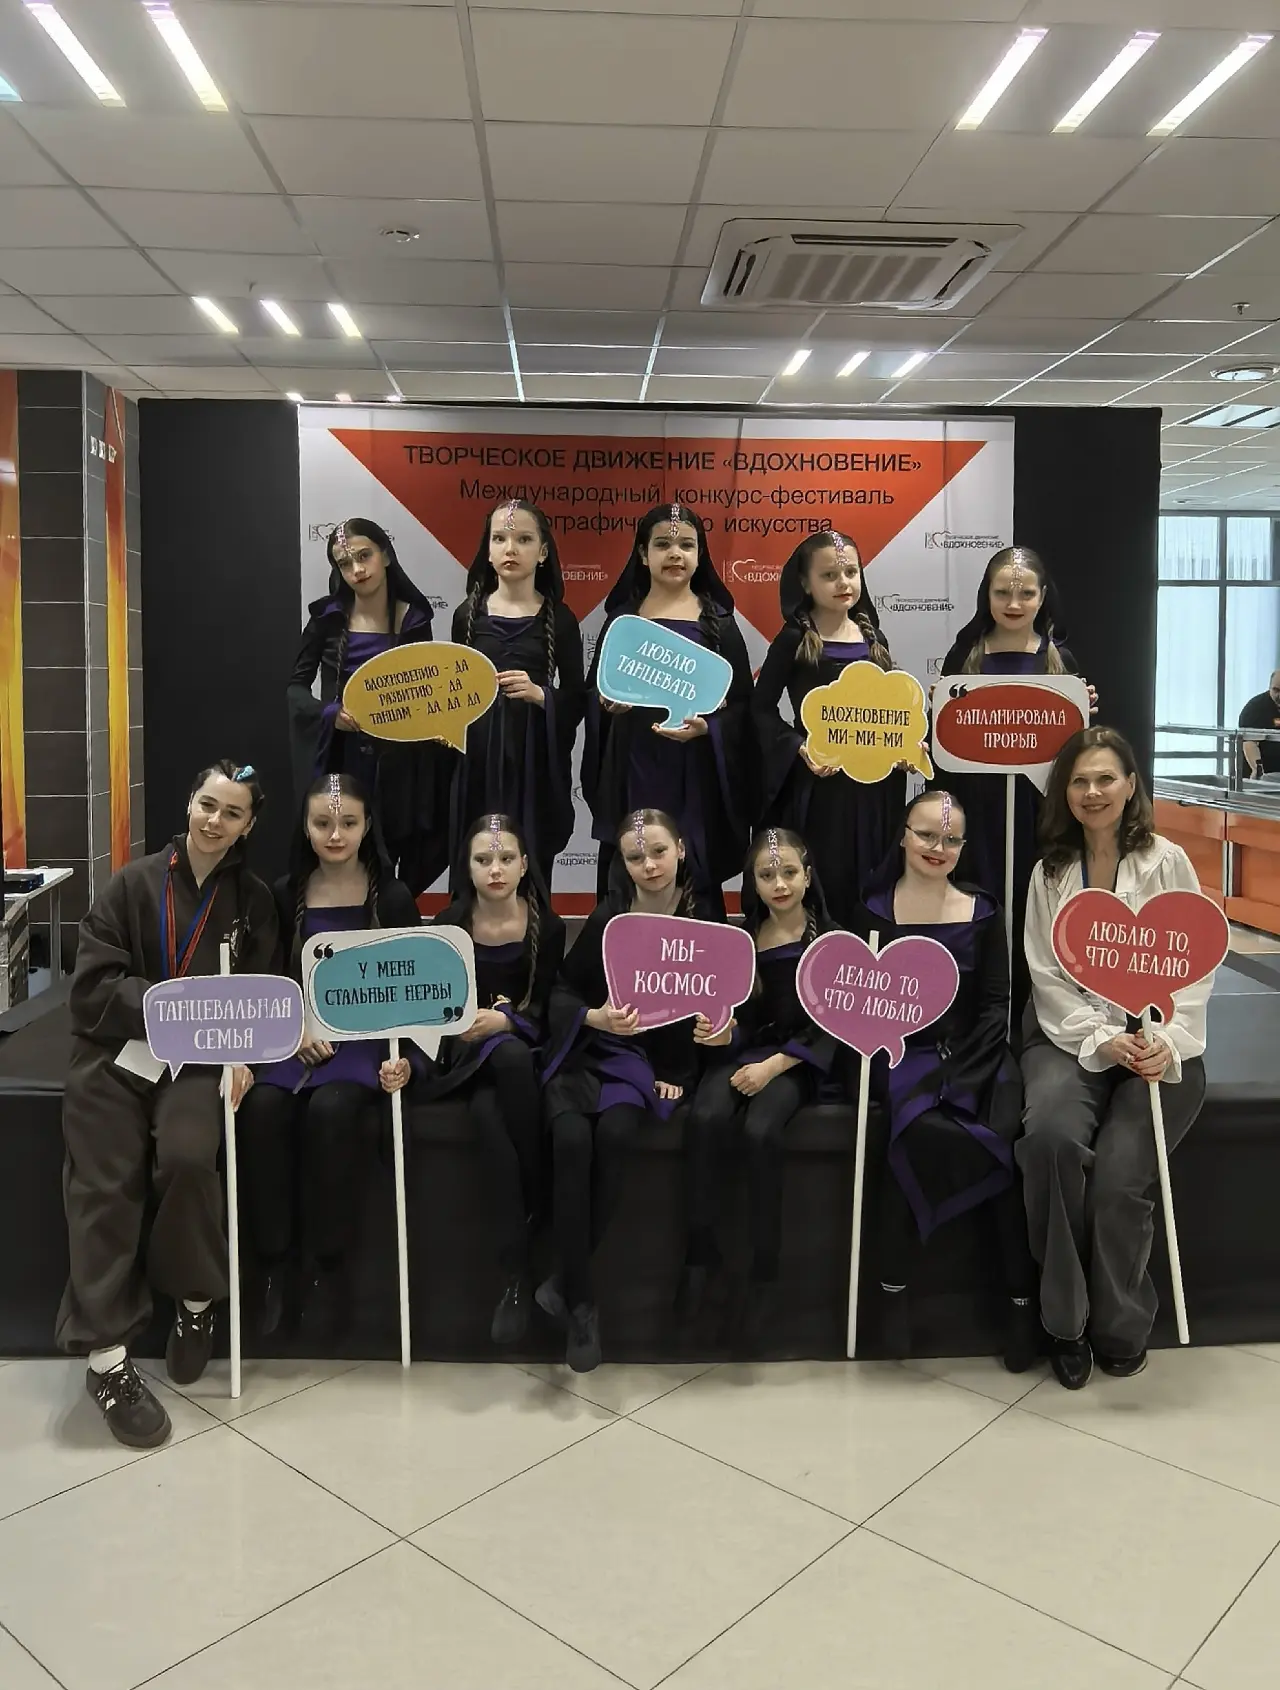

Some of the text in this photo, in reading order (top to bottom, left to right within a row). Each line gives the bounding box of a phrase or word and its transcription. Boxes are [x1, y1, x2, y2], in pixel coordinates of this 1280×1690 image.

[403, 445, 922, 476] ТВОРЧЕСКОЕ ДВИЖЕНИЕ «ВДОХНОВЕНИЕ»
[460, 479, 895, 509] Международный конкурс-фестиваль
[724, 517, 832, 537] искусства
[636, 640, 697, 675] ЛЮБЛЮ
[363, 665, 439, 691] ВДОХНОВЕНИЮ
[454, 659, 469, 674] ДА
[616, 654, 697, 701] ТАНЦЕВАТЬ
[378, 684, 433, 707] РАЗВИТИЮ
[448, 678, 463, 693] ДА
[369, 706, 412, 725] ТАНЦАМ
[427, 700, 442, 715] ДА
[447, 696, 461, 711] ДА
[467, 692, 481, 707] ДА
[821, 705, 911, 727] ВДОХНОВЕНИЕ
[956, 708, 1067, 726] ЗАПЛАНИРОВАЛА
[828, 728, 903, 748] МИ-МИ-МИ
[983, 732, 1038, 749] ПРОРЫВ
[660, 937, 705, 962] МЫ-
[1088, 921, 1190, 956] ЛЮБЛЮ ТО,
[358, 959, 415, 979] У МЕНЯ
[1085, 945, 1190, 978] ЧТО ДЕЛАЮ
[325, 982, 452, 1005] СТАЛЬНЫЕ НЕРВЫ
[634, 970, 717, 997] КОСМОС
[833, 963, 920, 999] ДЕЛАЮ ТО,
[154, 997, 292, 1022] ТАНЦЕВАЛЬНАЯ
[824, 987, 923, 1024] ЧТО ЛЮБЛЮ
[194, 1028, 254, 1049] СЕМЬЯ
